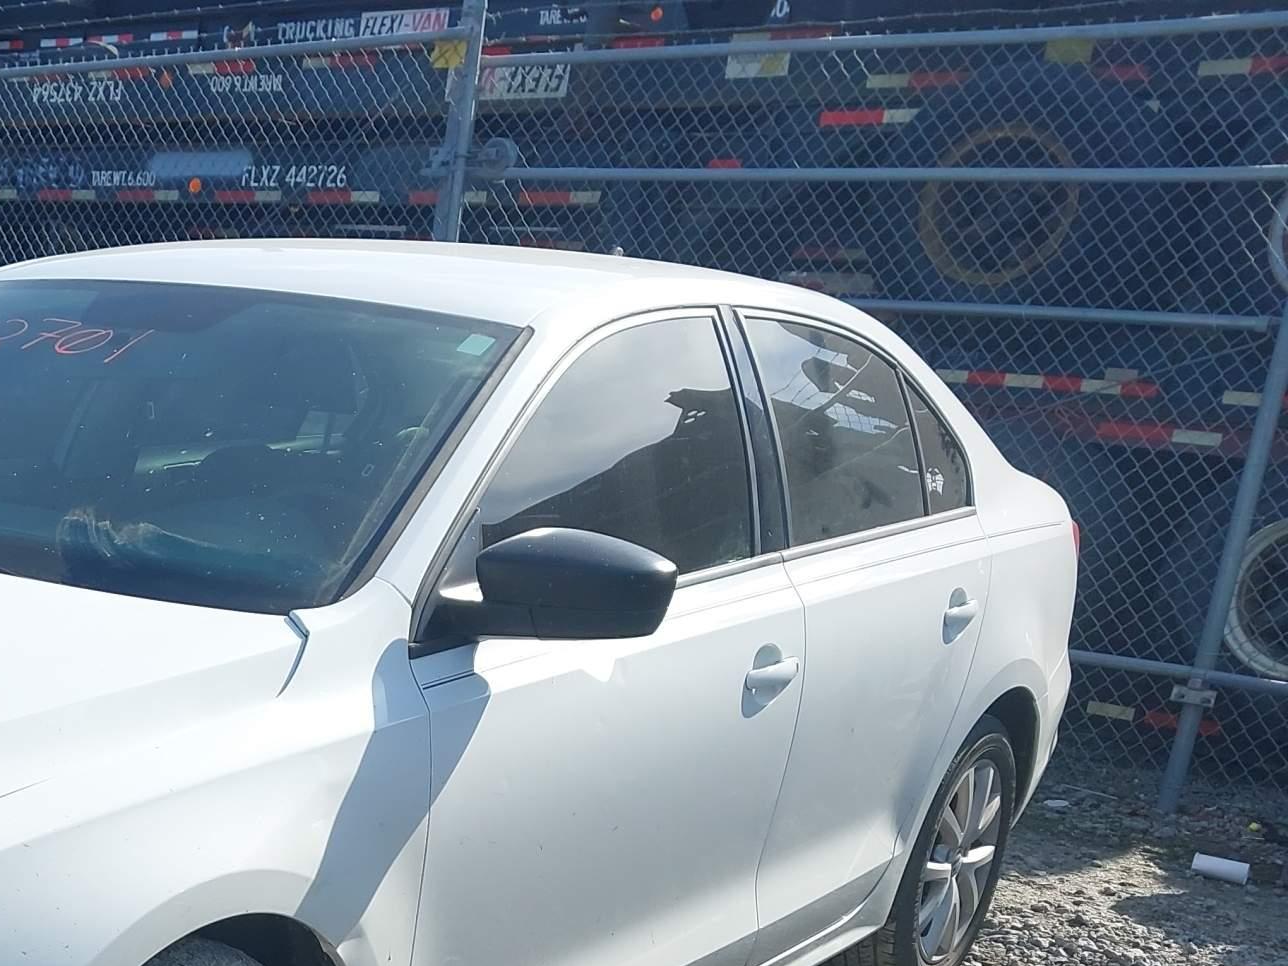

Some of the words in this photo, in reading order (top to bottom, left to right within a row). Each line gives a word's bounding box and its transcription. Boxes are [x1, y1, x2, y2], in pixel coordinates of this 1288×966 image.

[277, 18, 355, 41] TRUCKING
[363, 11, 446, 37] FLEXI-VAN
[241, 164, 281, 188] FLXZ
[285, 164, 348, 188] 442726
